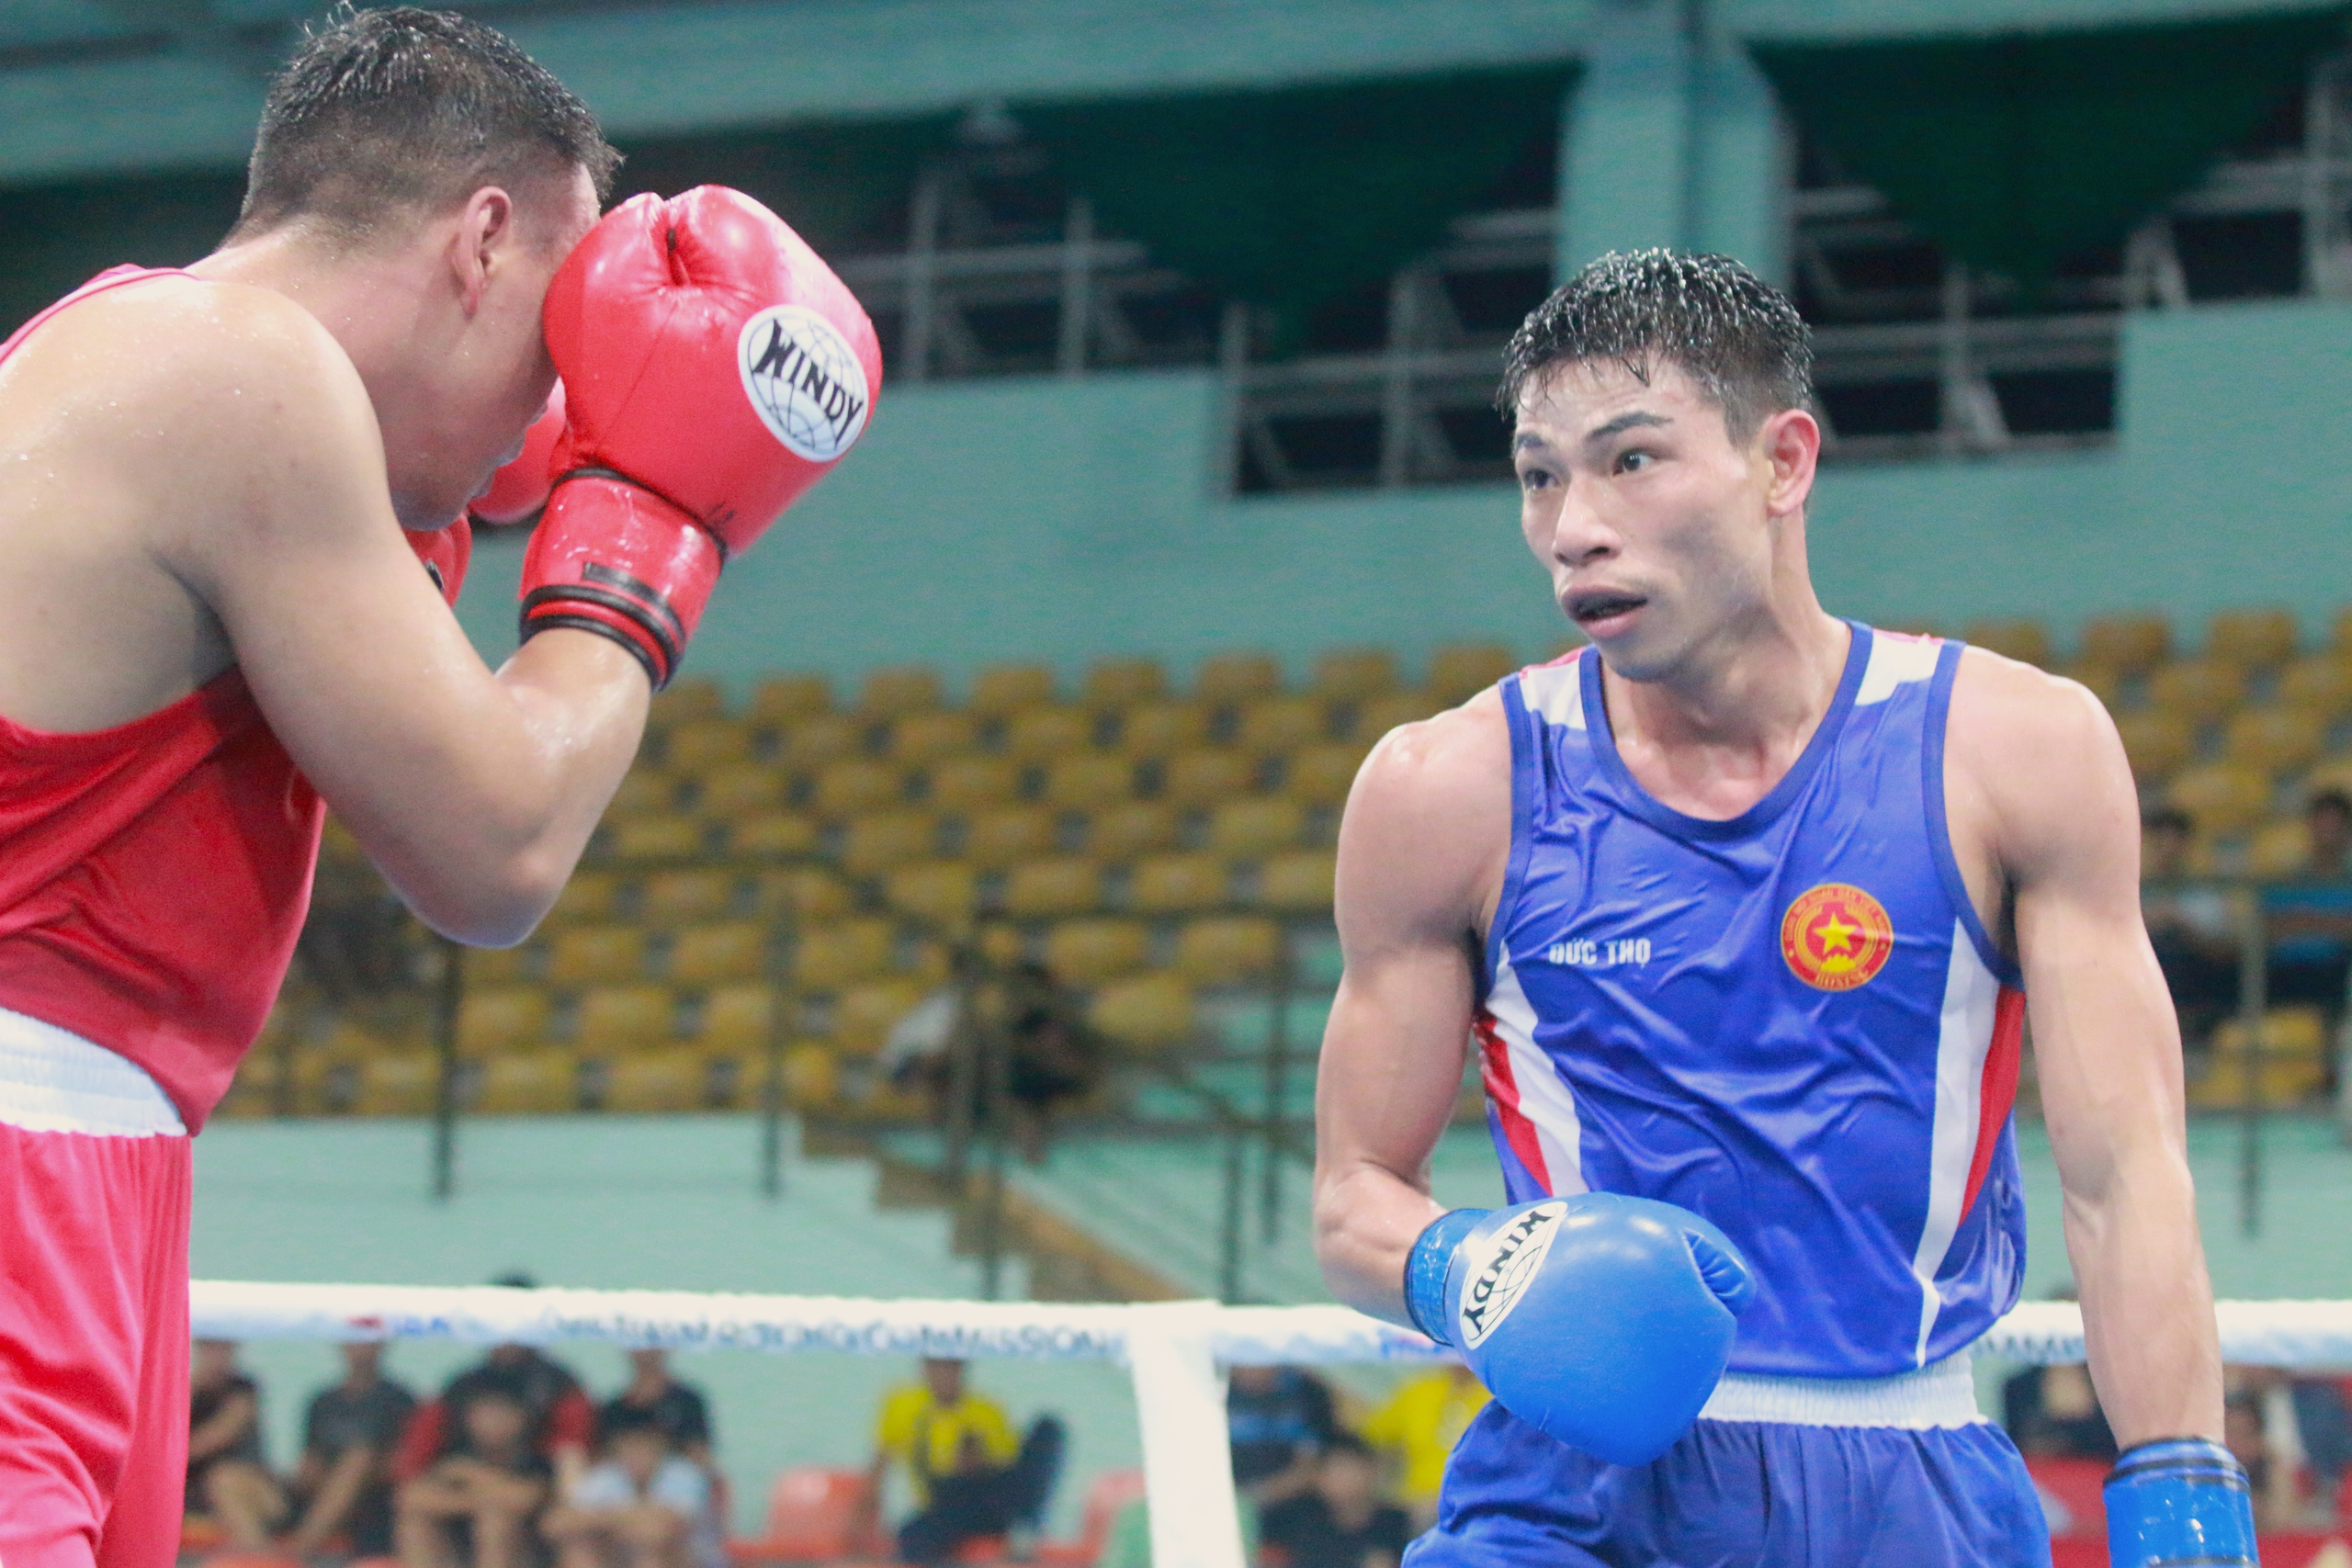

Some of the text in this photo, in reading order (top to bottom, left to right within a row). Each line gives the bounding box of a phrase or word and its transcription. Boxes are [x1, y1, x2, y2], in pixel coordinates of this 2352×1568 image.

[752, 318, 864, 451] WINDY
[1605, 938, 1651, 969] THỌ
[1462, 1210, 1555, 1334] WINDY
